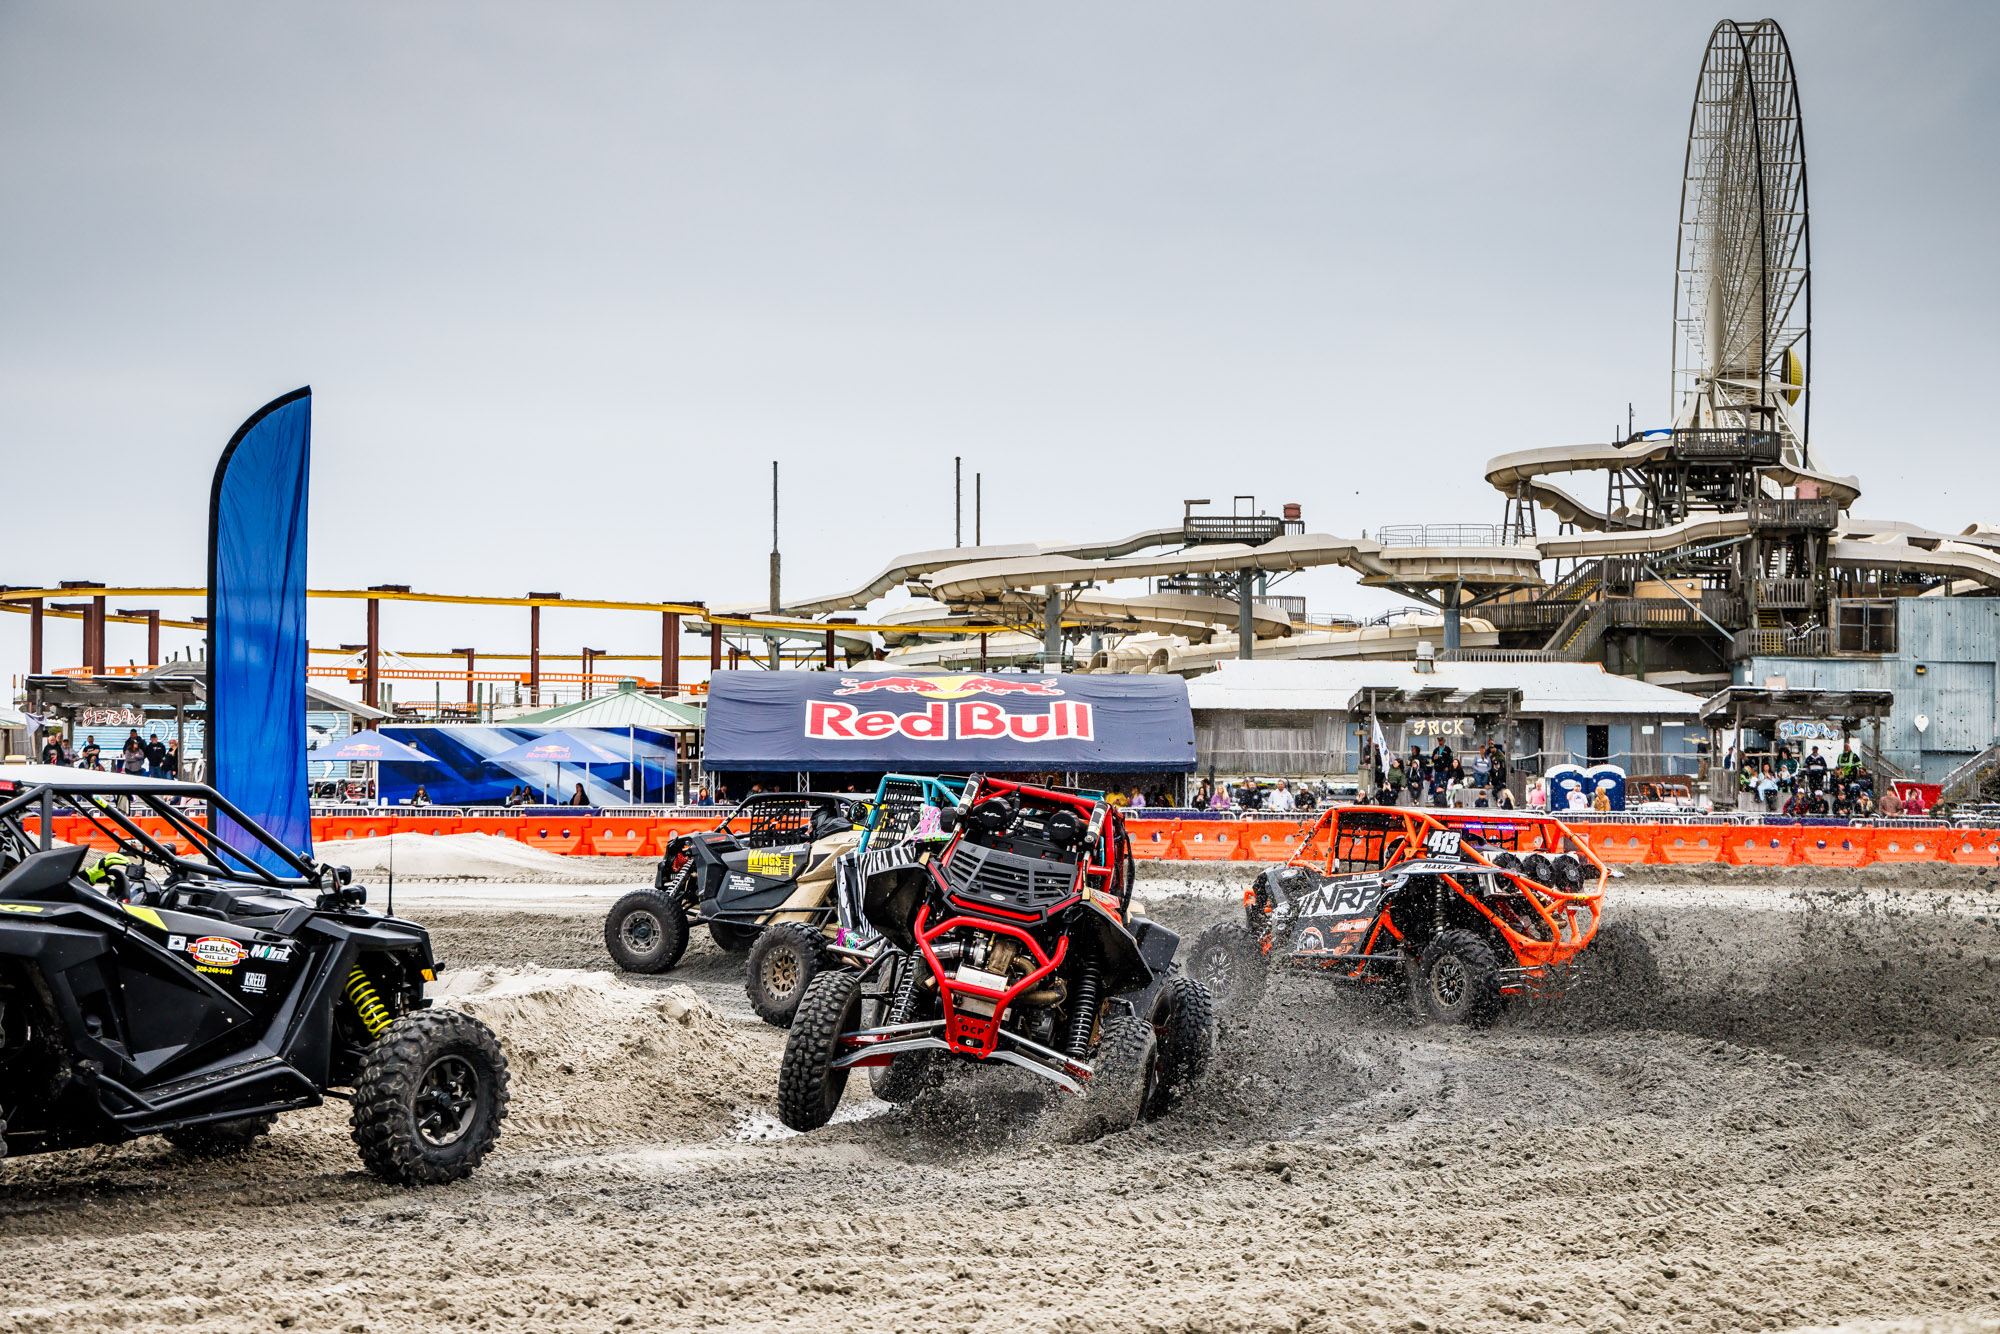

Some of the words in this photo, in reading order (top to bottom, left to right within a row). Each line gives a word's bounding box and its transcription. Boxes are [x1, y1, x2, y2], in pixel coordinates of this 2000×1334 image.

[82, 707, 143, 727] JETSAM
[808, 701, 946, 739] Red
[958, 700, 1092, 740] Bull
[1779, 720, 1839, 740] FLOTSAM
[1427, 830, 1460, 855] 413
[961, 1024, 984, 1035] OCP
